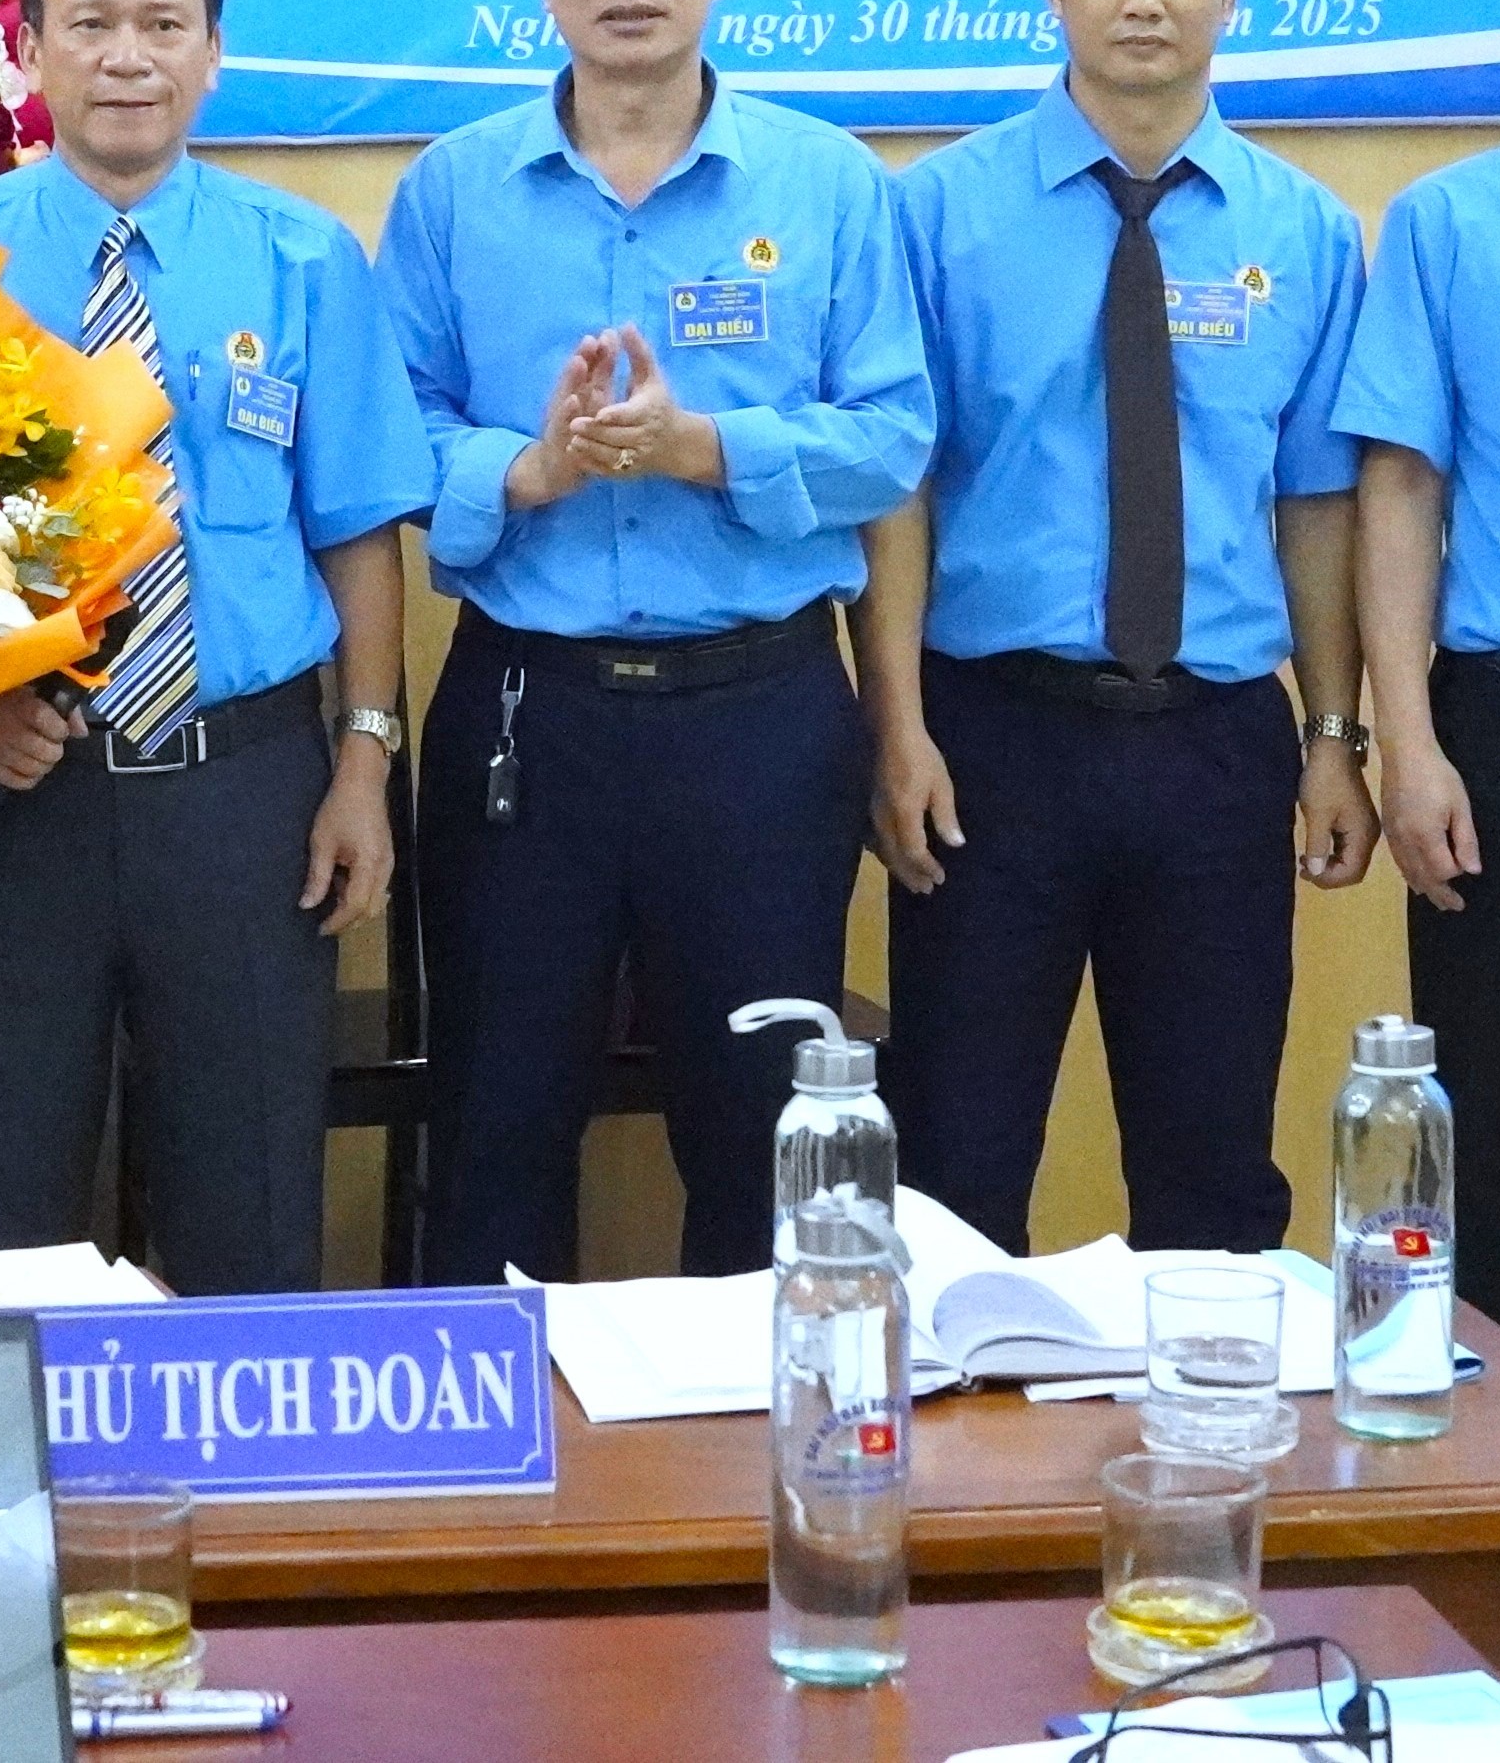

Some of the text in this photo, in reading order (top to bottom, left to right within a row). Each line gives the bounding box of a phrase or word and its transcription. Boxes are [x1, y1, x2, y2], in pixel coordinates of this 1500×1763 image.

[717, 0, 835, 55] ngày
[850, 0, 909, 44] 30
[717, 315, 754, 336] BIỂU
[42, 1328, 516, 1463] HỦ TỊCH ĐOÀN
